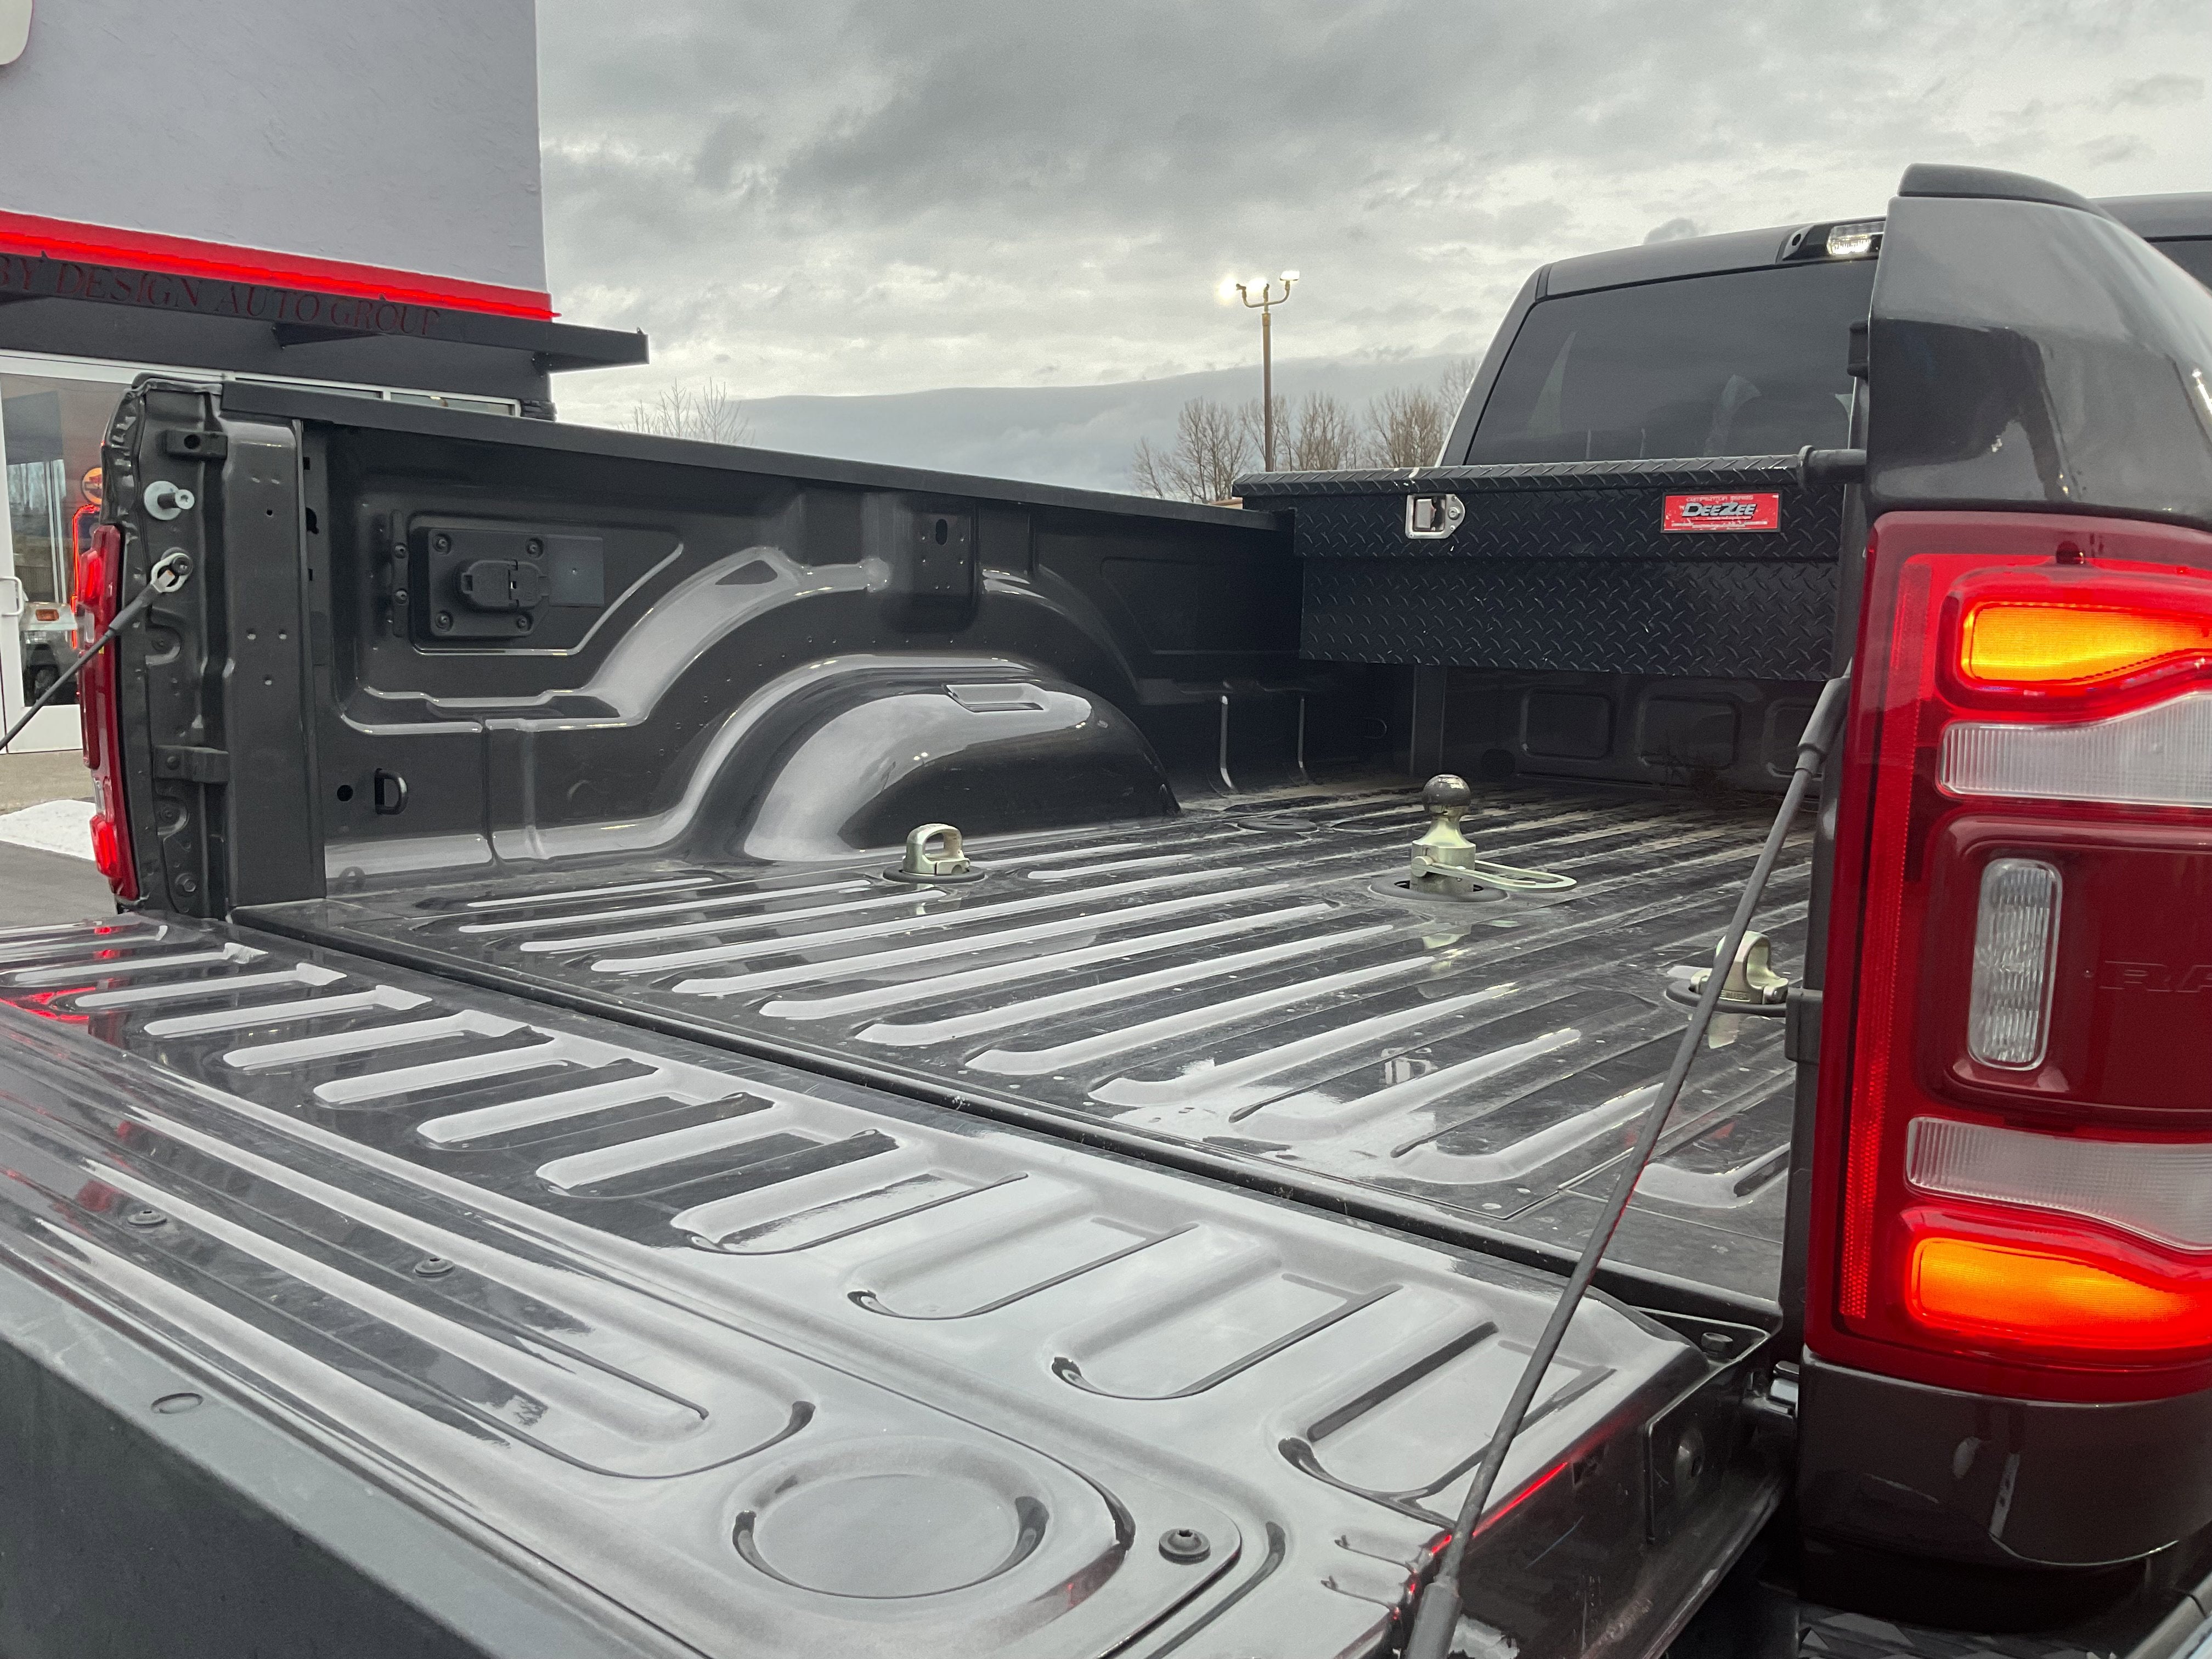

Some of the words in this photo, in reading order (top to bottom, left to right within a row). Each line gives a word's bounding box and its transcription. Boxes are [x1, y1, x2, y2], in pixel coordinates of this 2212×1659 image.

[56, 263, 204, 307] DESIGN
[214, 285, 320, 322] AUTO
[330, 298, 440, 335] GROUP
